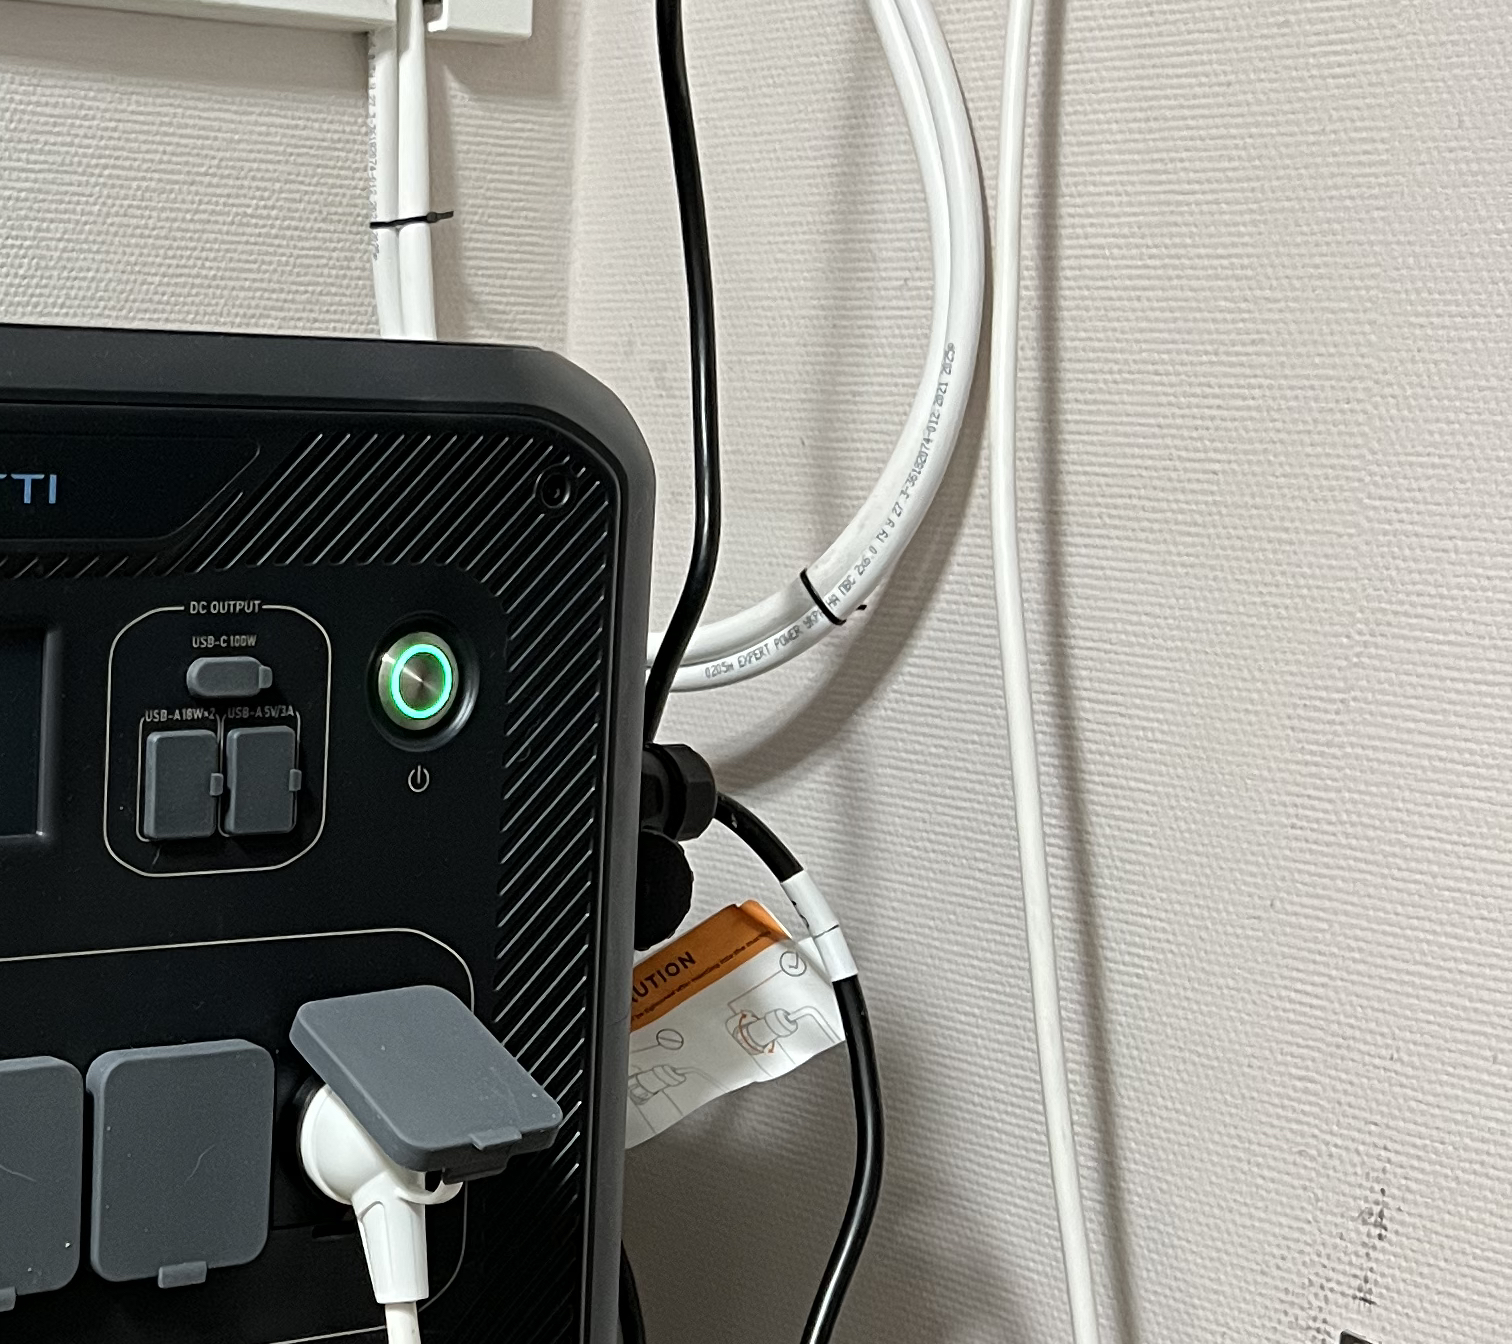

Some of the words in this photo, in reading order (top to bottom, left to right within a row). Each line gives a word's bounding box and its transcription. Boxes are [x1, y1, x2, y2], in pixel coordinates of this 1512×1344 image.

[189, 601, 207, 614] DC
[210, 600, 261, 614] OUTPUT
[192, 635, 228, 648] USB-C
[230, 634, 257, 647] 100W
[737, 643, 771, 669] EXPERT
[773, 624, 806, 650] POWER
[145, 709, 181, 722] USB-A
[227, 707, 263, 719] USB-A
[264, 704, 295, 718] 5V/3A
[632, 951, 696, 1003] UTION
